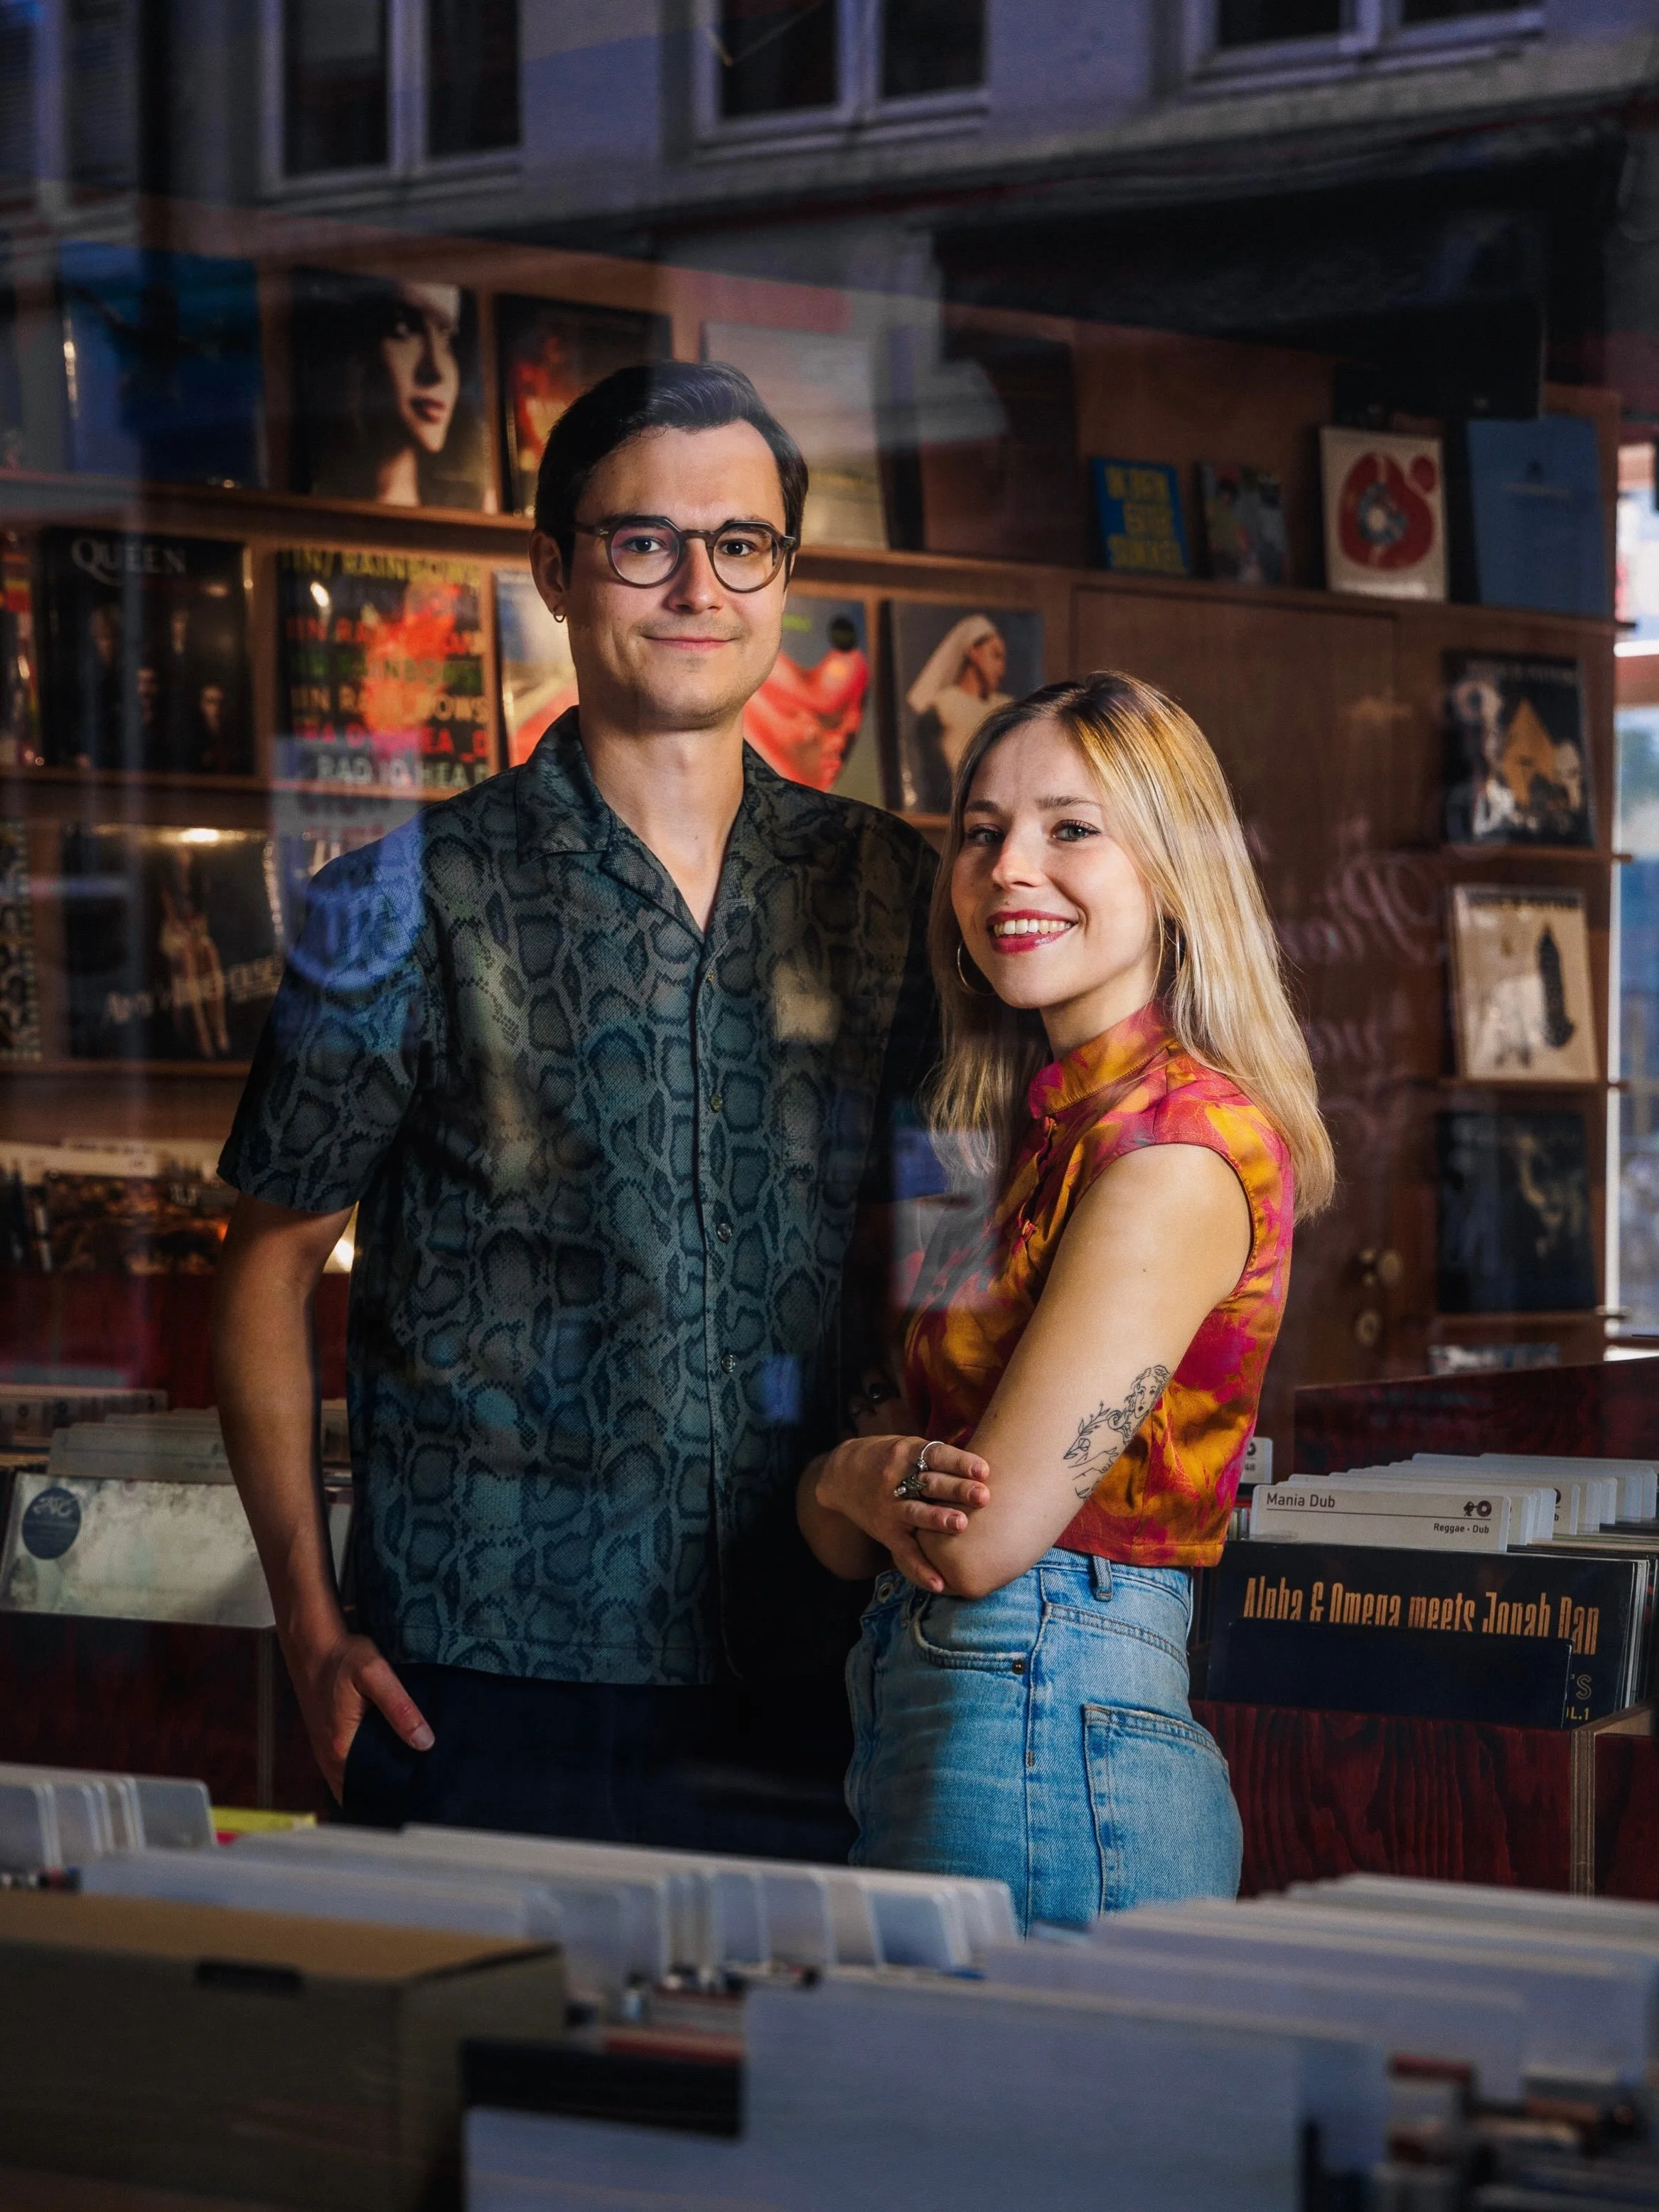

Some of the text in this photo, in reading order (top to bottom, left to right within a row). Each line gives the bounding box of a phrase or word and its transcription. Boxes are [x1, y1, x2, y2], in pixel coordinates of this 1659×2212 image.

[71, 538, 187, 585] QUEEN
[1266, 1492, 1336, 1508] Mania Dub
[1433, 1523, 1490, 1534] Reggae Dub
[1309, 1581, 1325, 1623] &
[1407, 1592, 1476, 1633] meets
[1481, 1591, 1552, 1638] Jonah
[1566, 1706, 1591, 1721] L.1
